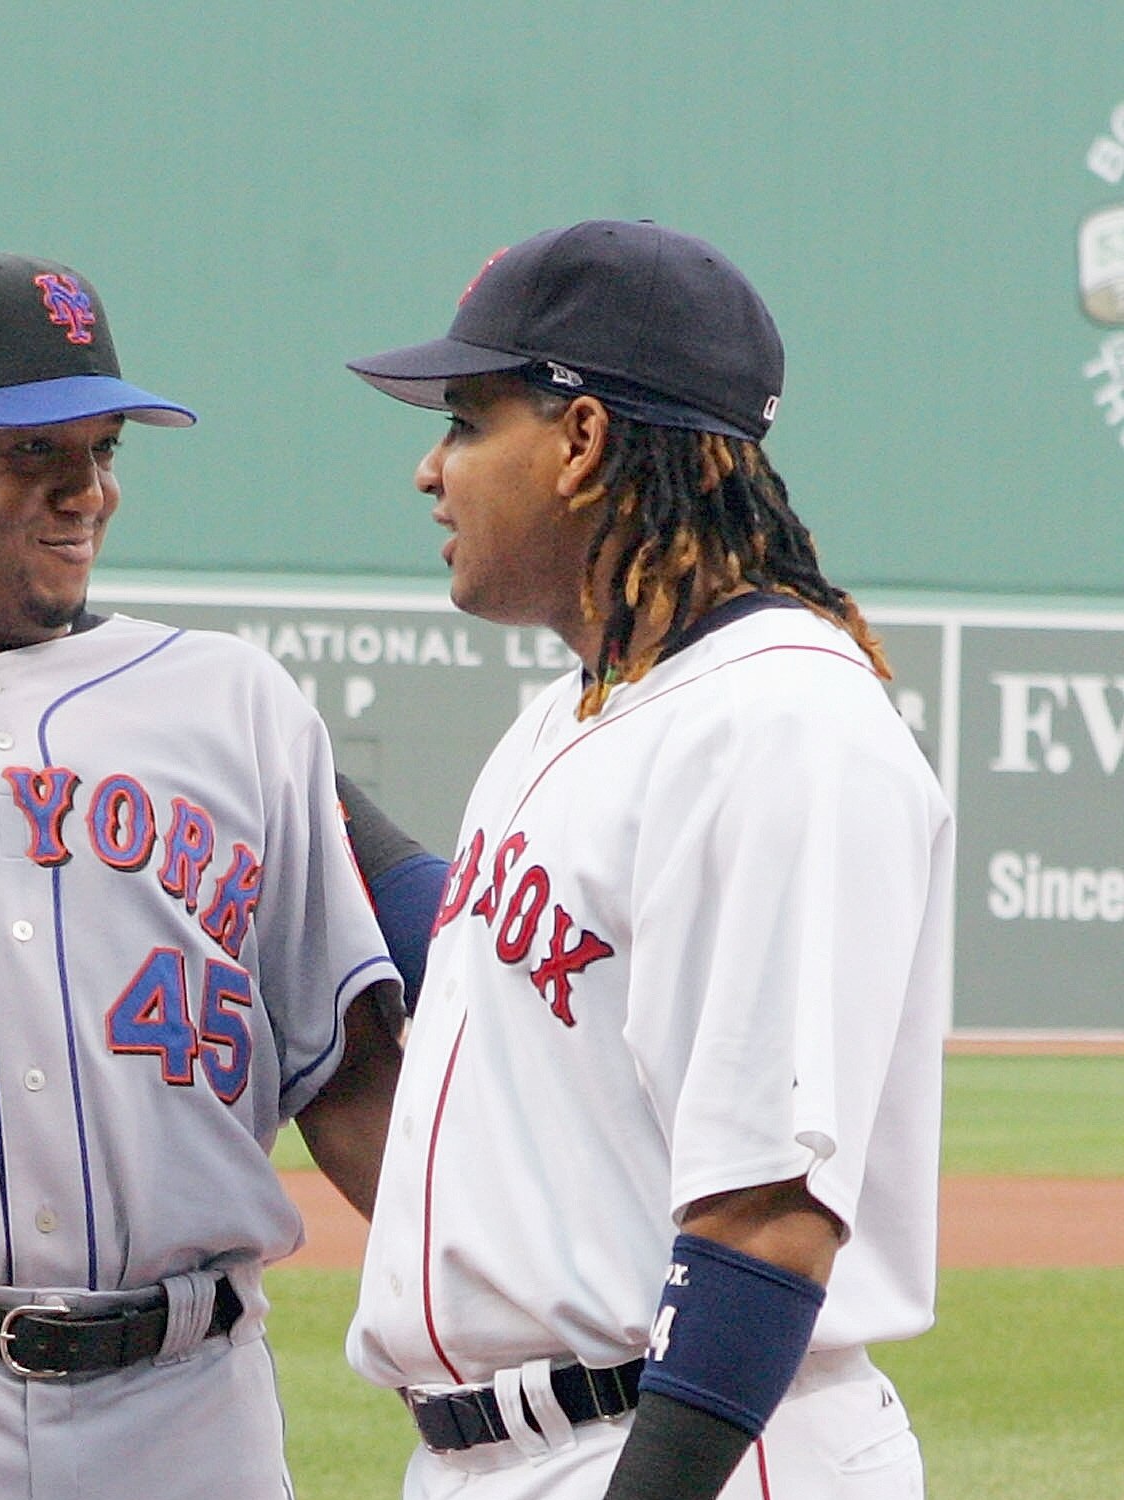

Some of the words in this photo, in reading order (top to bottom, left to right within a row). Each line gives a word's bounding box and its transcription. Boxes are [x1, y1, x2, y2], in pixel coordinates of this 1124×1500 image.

[237, 622, 482, 669] NATIONAL
[506, 630, 579, 669] LE
[2, 766, 264, 959] YORK
[987, 850, 1124, 923] Since
[471, 830, 615, 1028] SOX
[104, 946, 254, 1106] 45
[644, 1304, 676, 1361] 4
